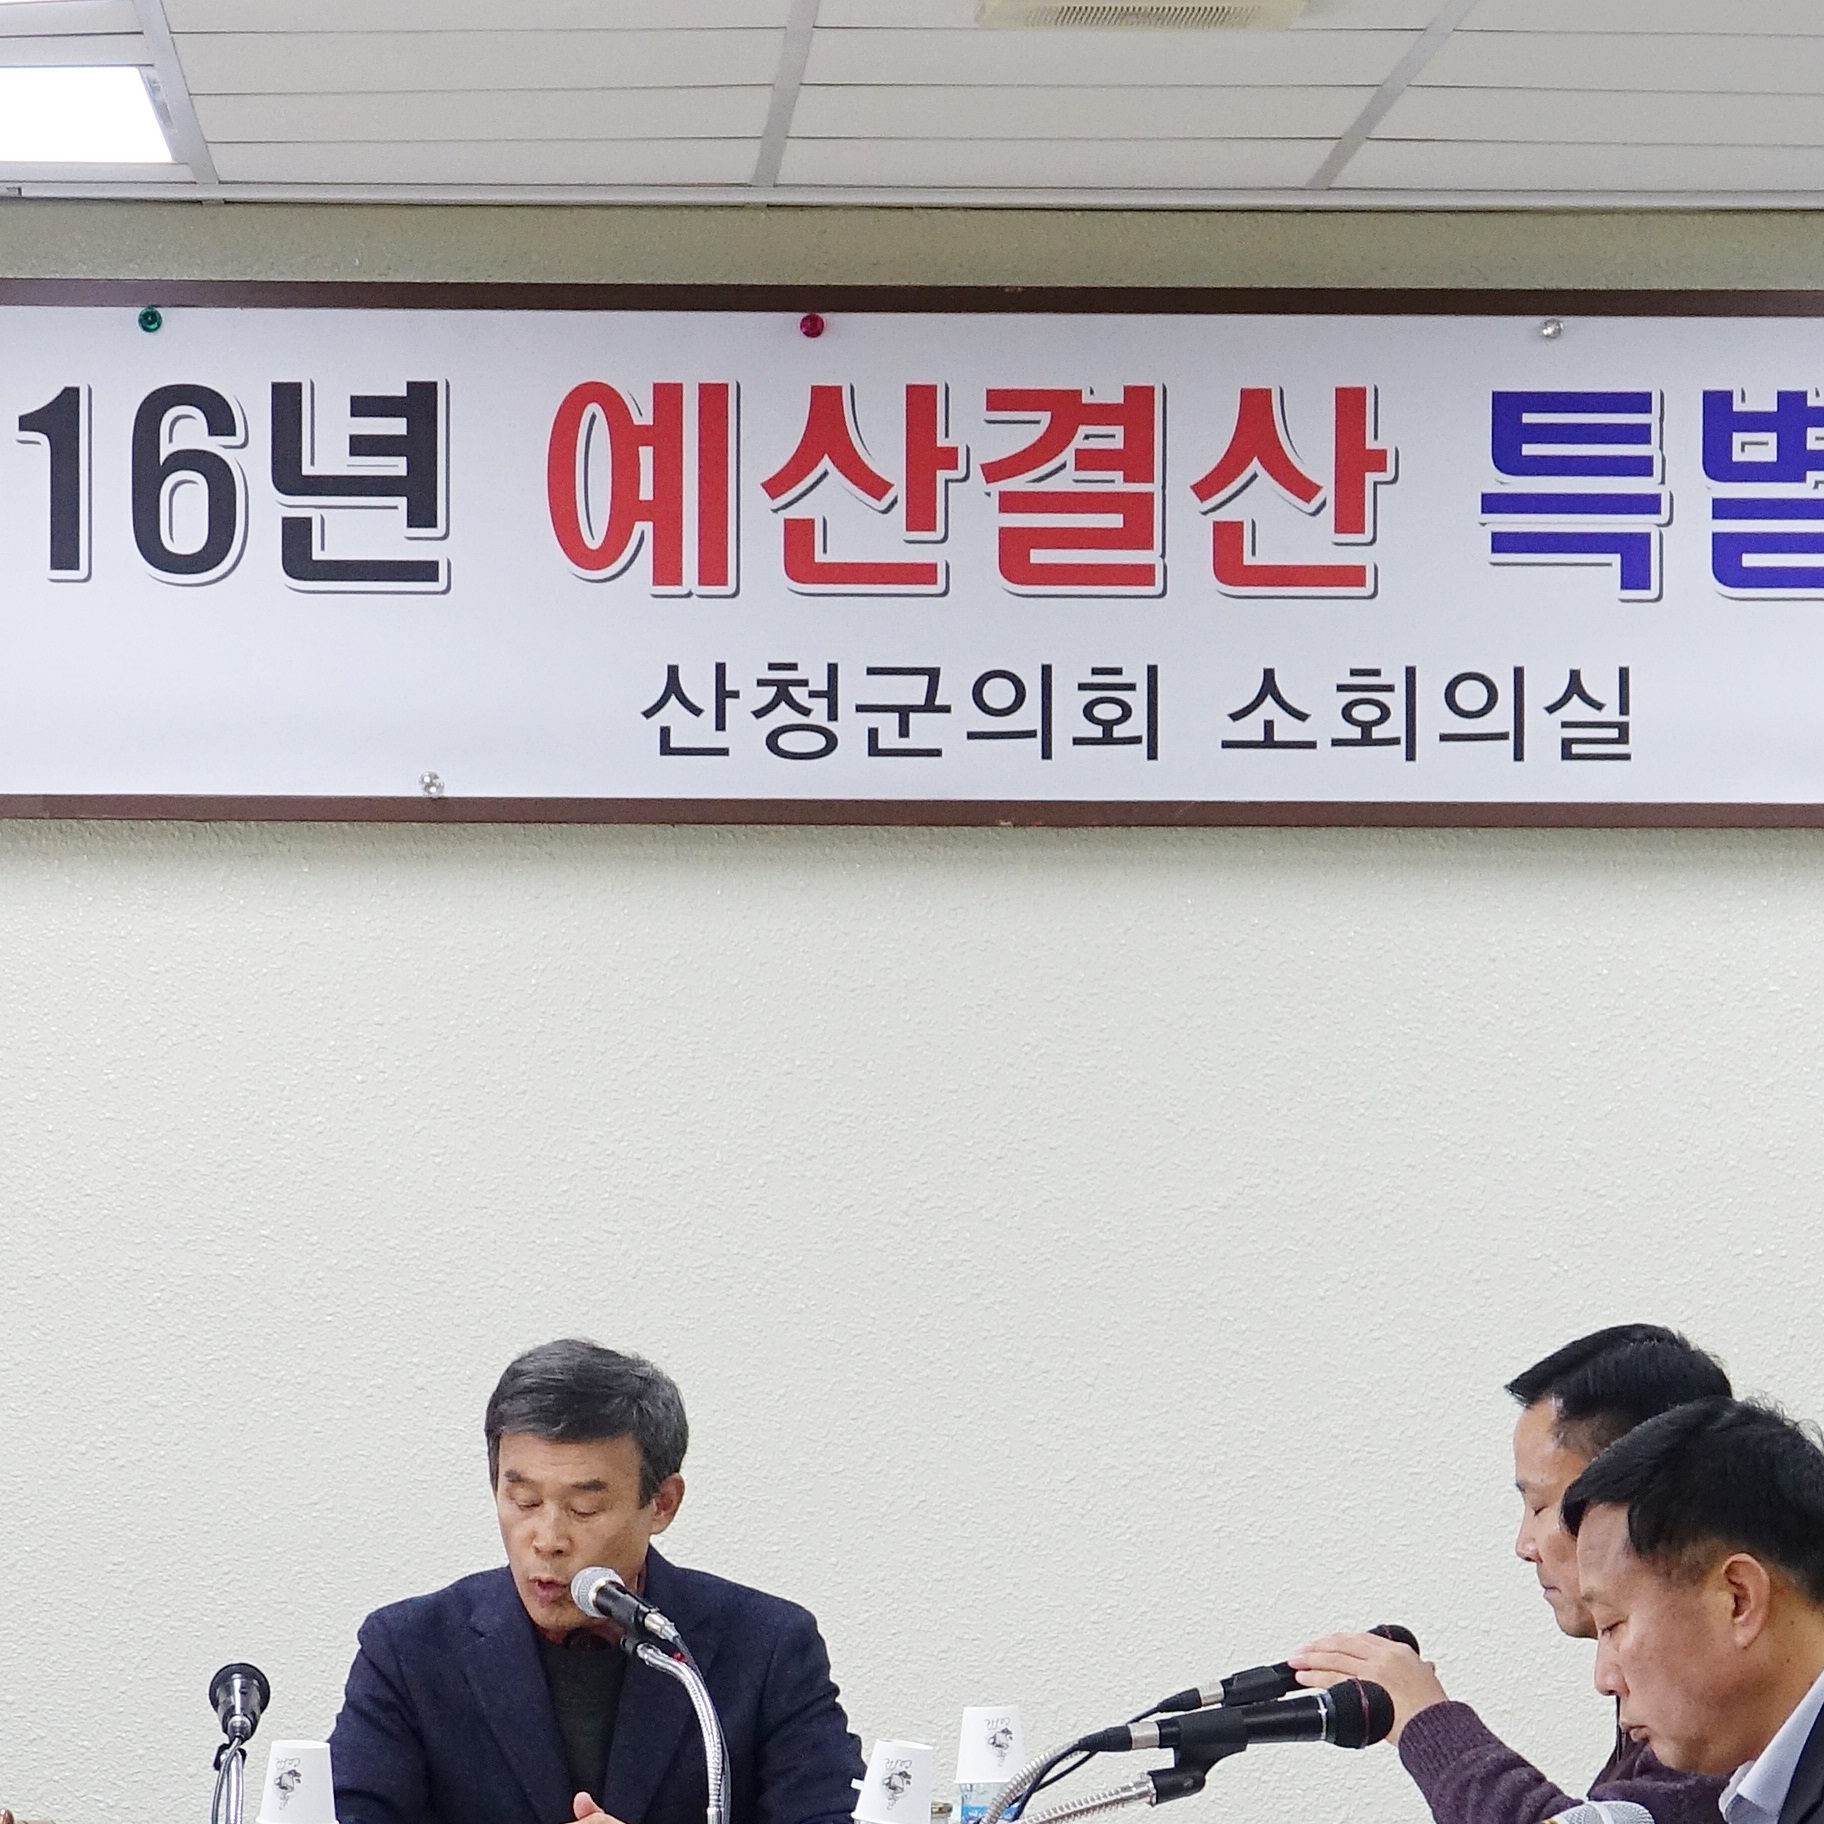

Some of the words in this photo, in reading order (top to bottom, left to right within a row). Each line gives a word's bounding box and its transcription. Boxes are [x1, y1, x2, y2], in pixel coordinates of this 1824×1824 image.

[547, 381, 1388, 592] 예산결산
[641, 662, 1159, 761] 산청군의회
[1221, 666, 1632, 762] 소회의실
